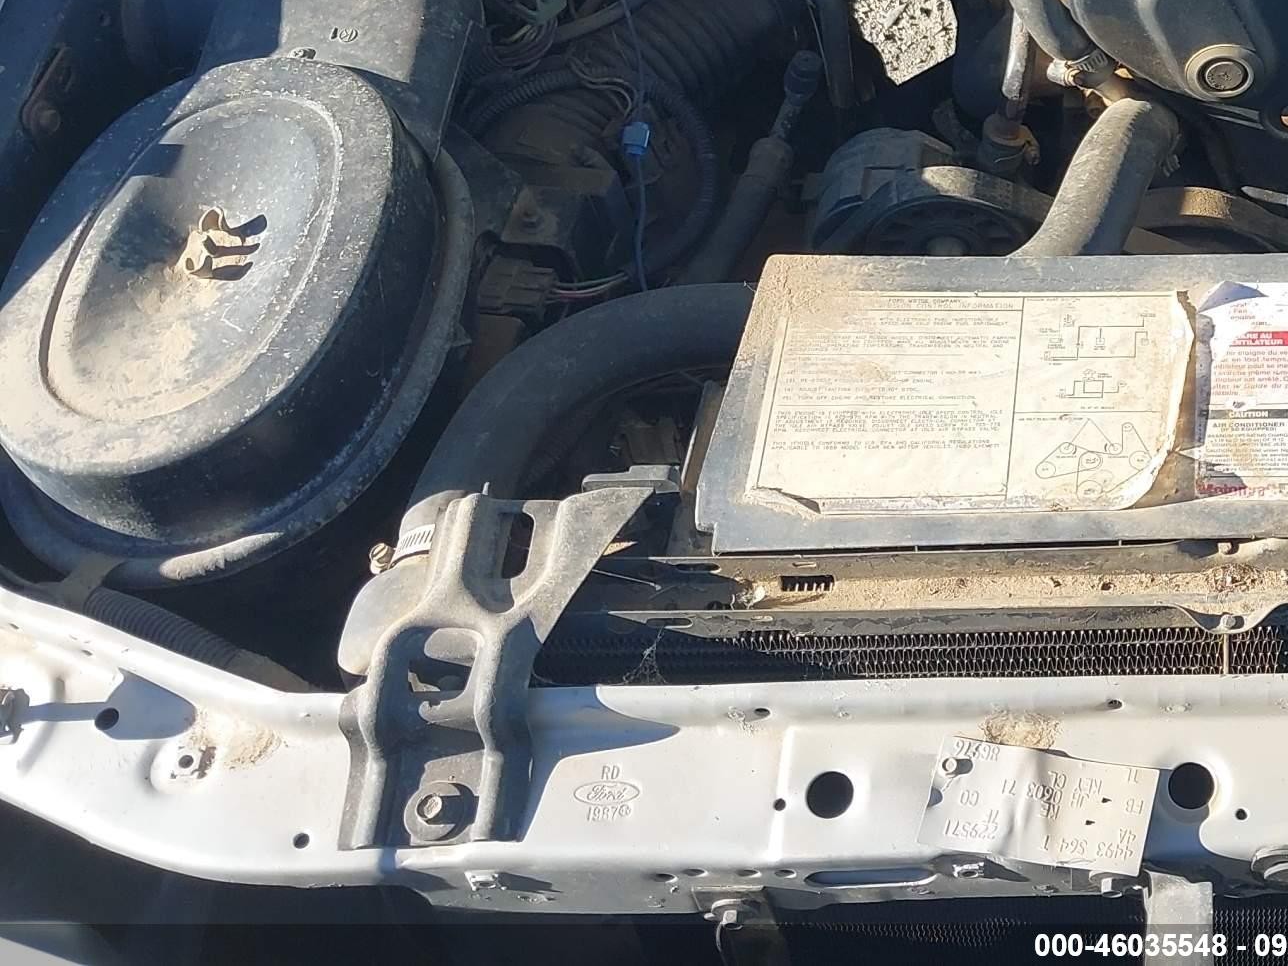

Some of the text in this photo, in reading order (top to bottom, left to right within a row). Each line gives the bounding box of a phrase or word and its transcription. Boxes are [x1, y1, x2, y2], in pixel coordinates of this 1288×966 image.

[1229, 410, 1269, 418] CAUTION
[601, 765, 621, 780] RD
[587, 784, 628, 802] Ford
[1026, 783, 1064, 802] 0603
[1075, 777, 1104, 795] KEY
[959, 790, 981, 807] CO
[943, 818, 999, 842] 229571
[1118, 827, 1138, 845] 4A
[1059, 836, 1089, 854] 564
[1097, 841, 1135, 859] 4493
